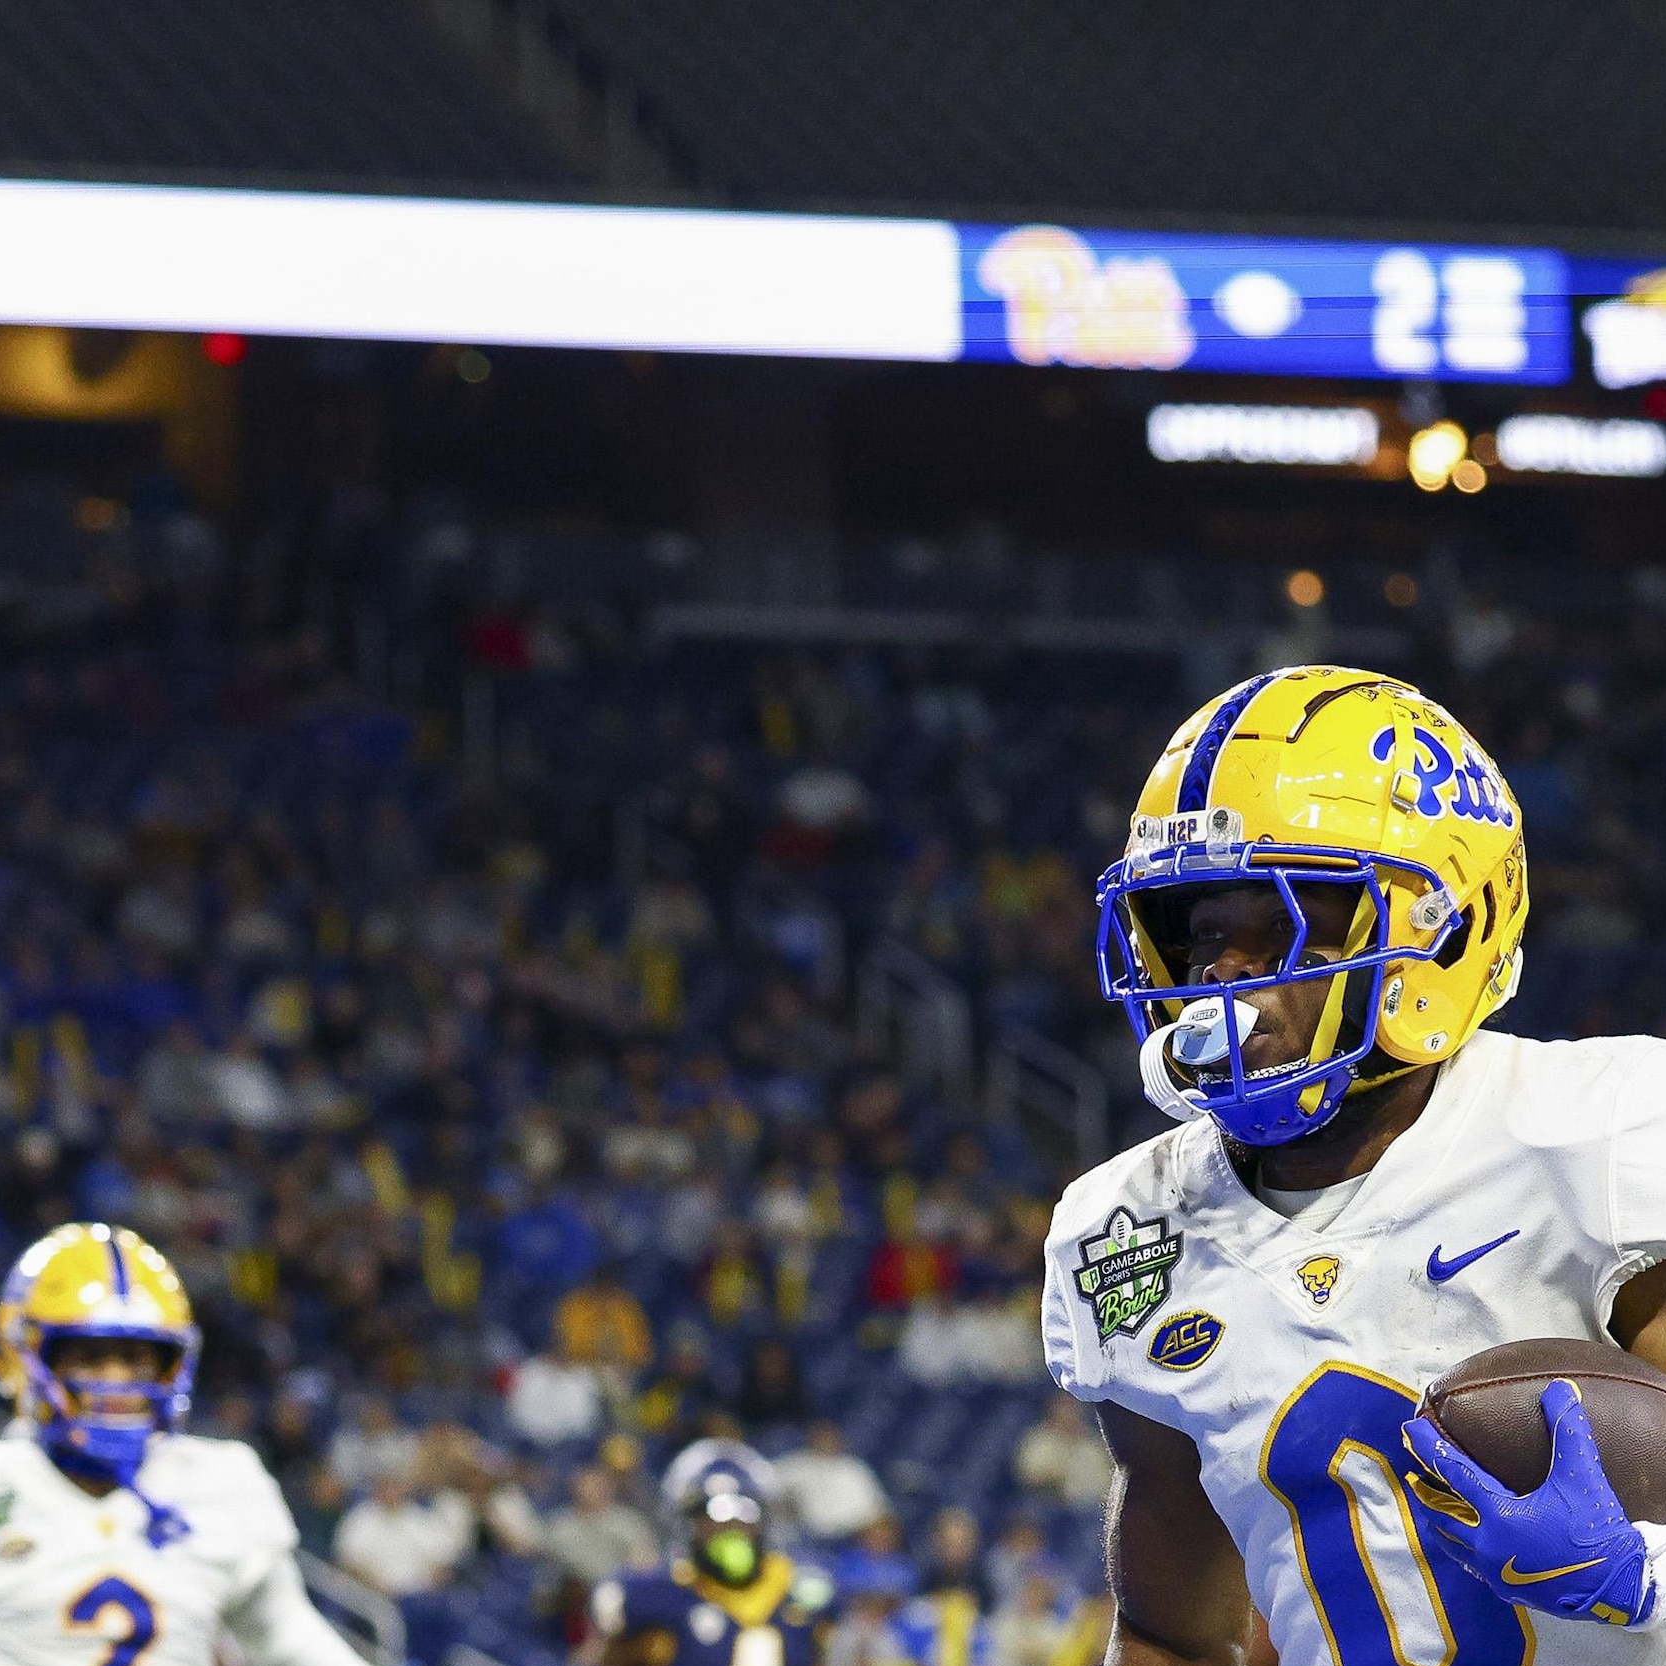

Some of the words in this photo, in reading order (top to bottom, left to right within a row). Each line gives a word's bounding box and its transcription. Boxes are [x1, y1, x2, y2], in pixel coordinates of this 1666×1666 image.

[1370, 724, 1514, 830] Pitt
[1167, 818, 1197, 843] H2P
[1101, 1240, 1177, 1275] GAMEABOVE
[1103, 1269, 1132, 1287] SPORTS
[1100, 1269, 1163, 1335] Bowl
[1160, 1316, 1212, 1356] ACC
